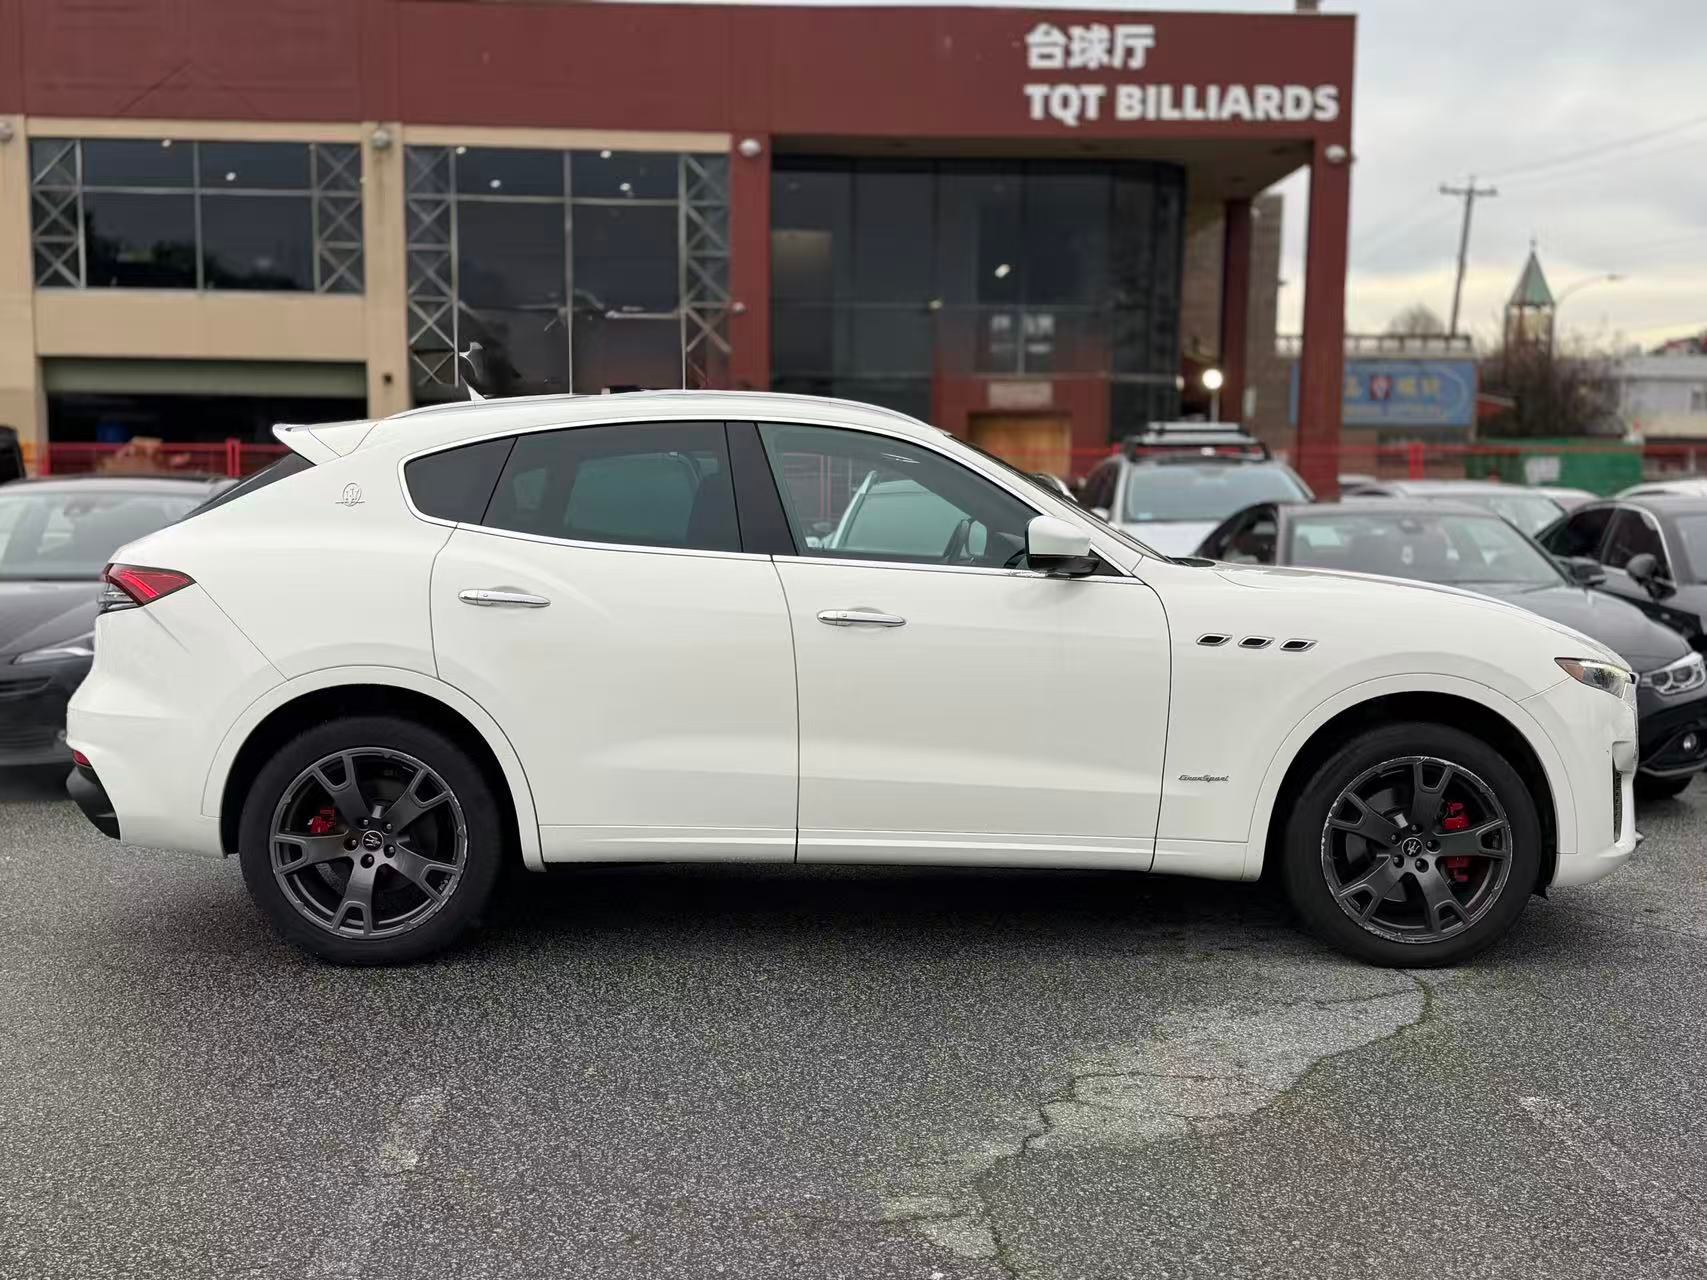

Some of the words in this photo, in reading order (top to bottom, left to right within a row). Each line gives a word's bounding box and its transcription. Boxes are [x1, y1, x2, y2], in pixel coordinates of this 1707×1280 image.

[1025, 23, 1155, 69] 台球厅
[1024, 84, 1107, 126] TQT
[1115, 84, 1339, 120] BILLIARDS
